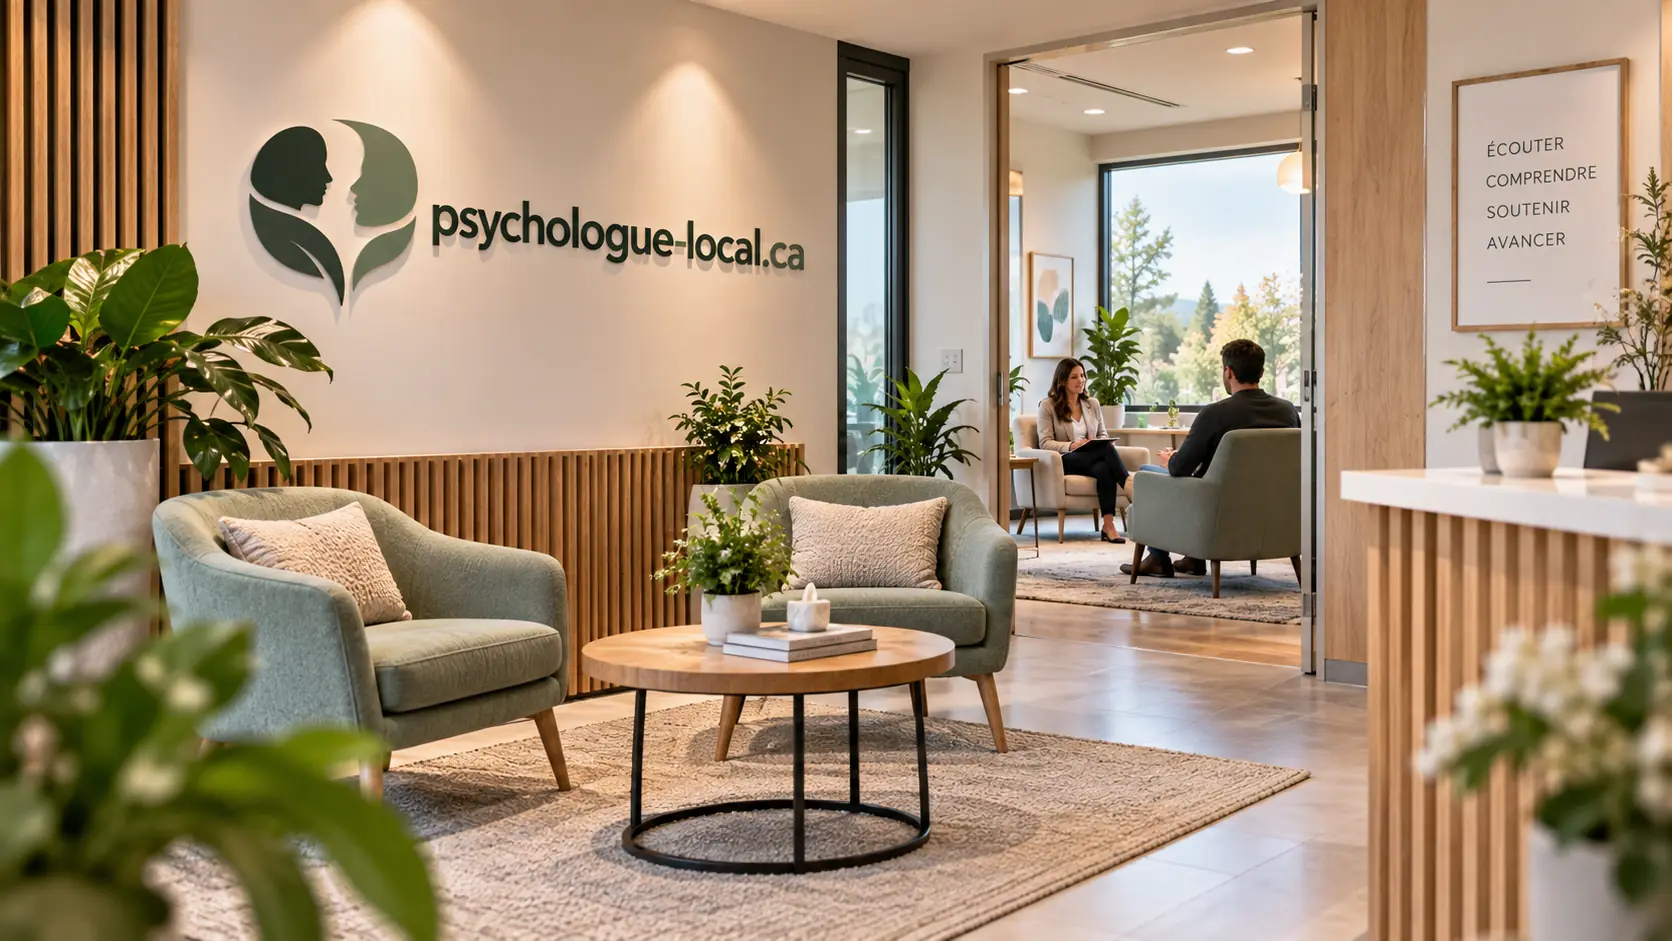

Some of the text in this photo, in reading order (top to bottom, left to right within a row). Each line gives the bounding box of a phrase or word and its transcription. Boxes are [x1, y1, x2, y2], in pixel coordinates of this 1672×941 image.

[1487, 136, 1564, 158] ÉCOUTER
[1486, 165, 1597, 188] COMPRENDRE
[1486, 200, 1570, 219] SOUTENIR
[432, 200, 804, 271] psychologue-local.ca
[1486, 232, 1566, 250] AVANCER
